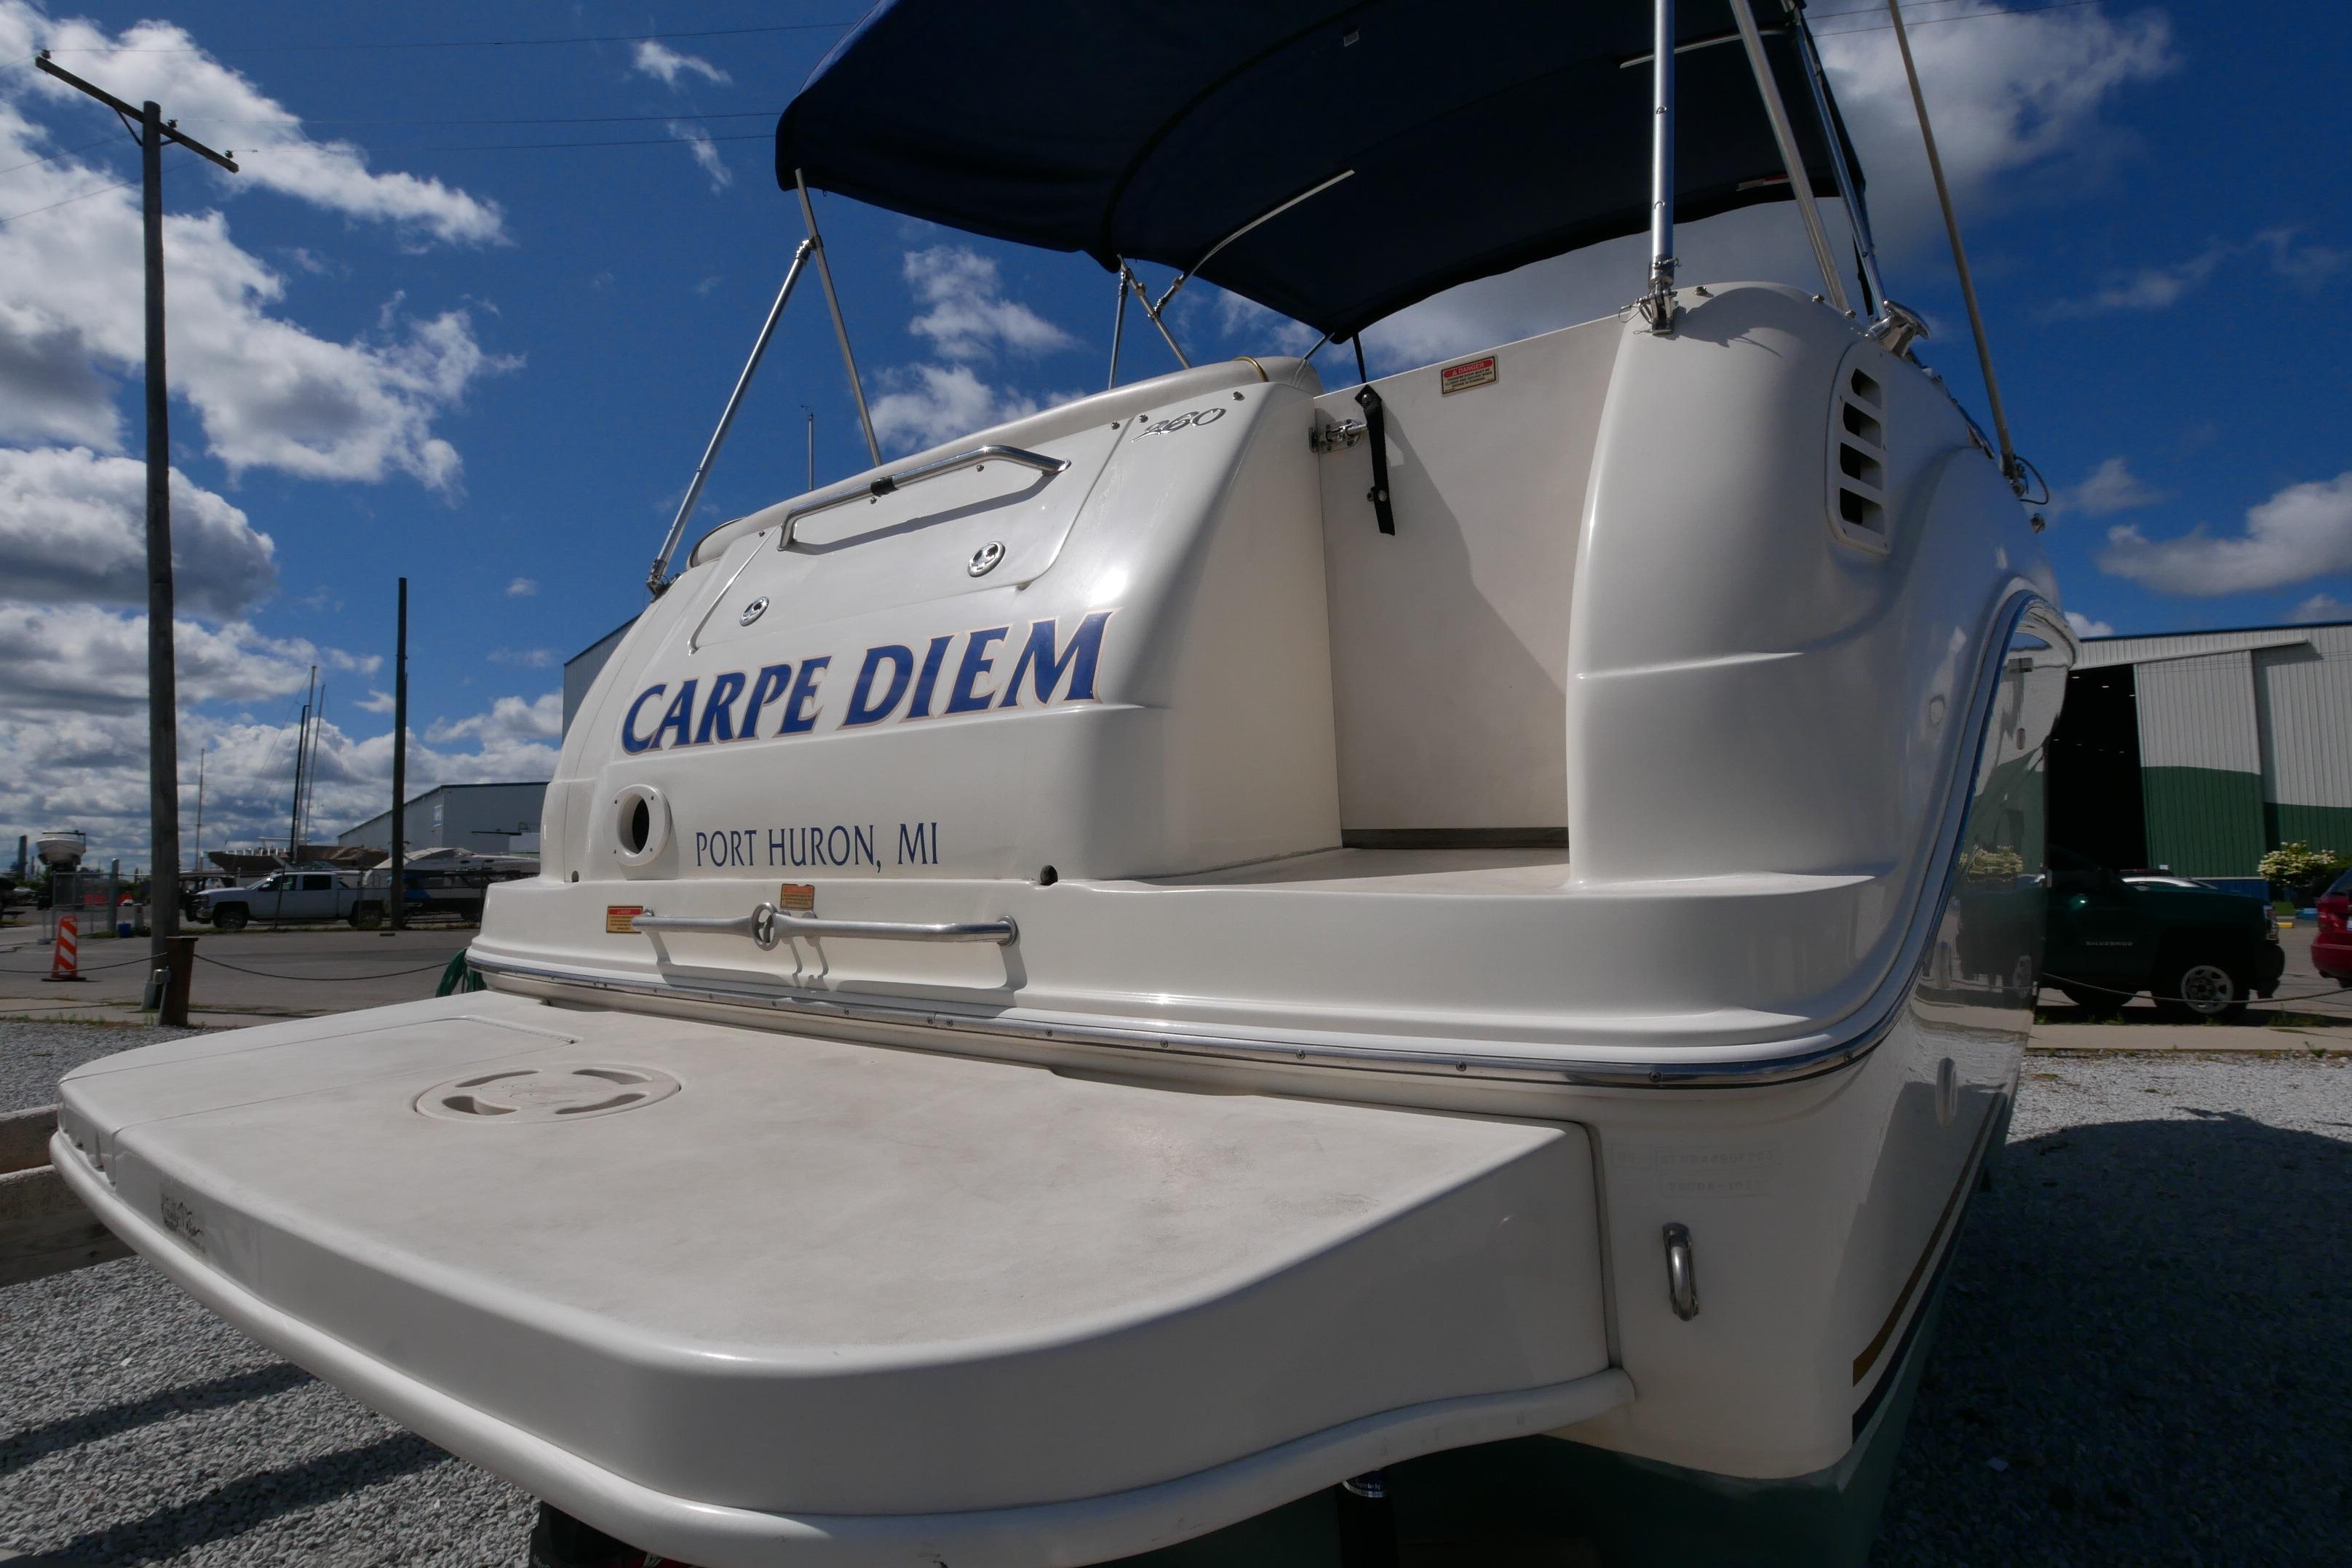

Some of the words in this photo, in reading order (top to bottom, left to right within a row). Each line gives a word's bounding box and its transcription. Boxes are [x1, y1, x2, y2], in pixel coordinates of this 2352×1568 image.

[1458, 362, 1485, 374] DANGER
[1131, 407, 1227, 442] 260
[621, 654, 834, 755] CARPE
[837, 608, 1122, 730] DIEM
[696, 829, 757, 867] PORT
[768, 825, 882, 873] HURON,
[897, 822, 938, 865] MI
